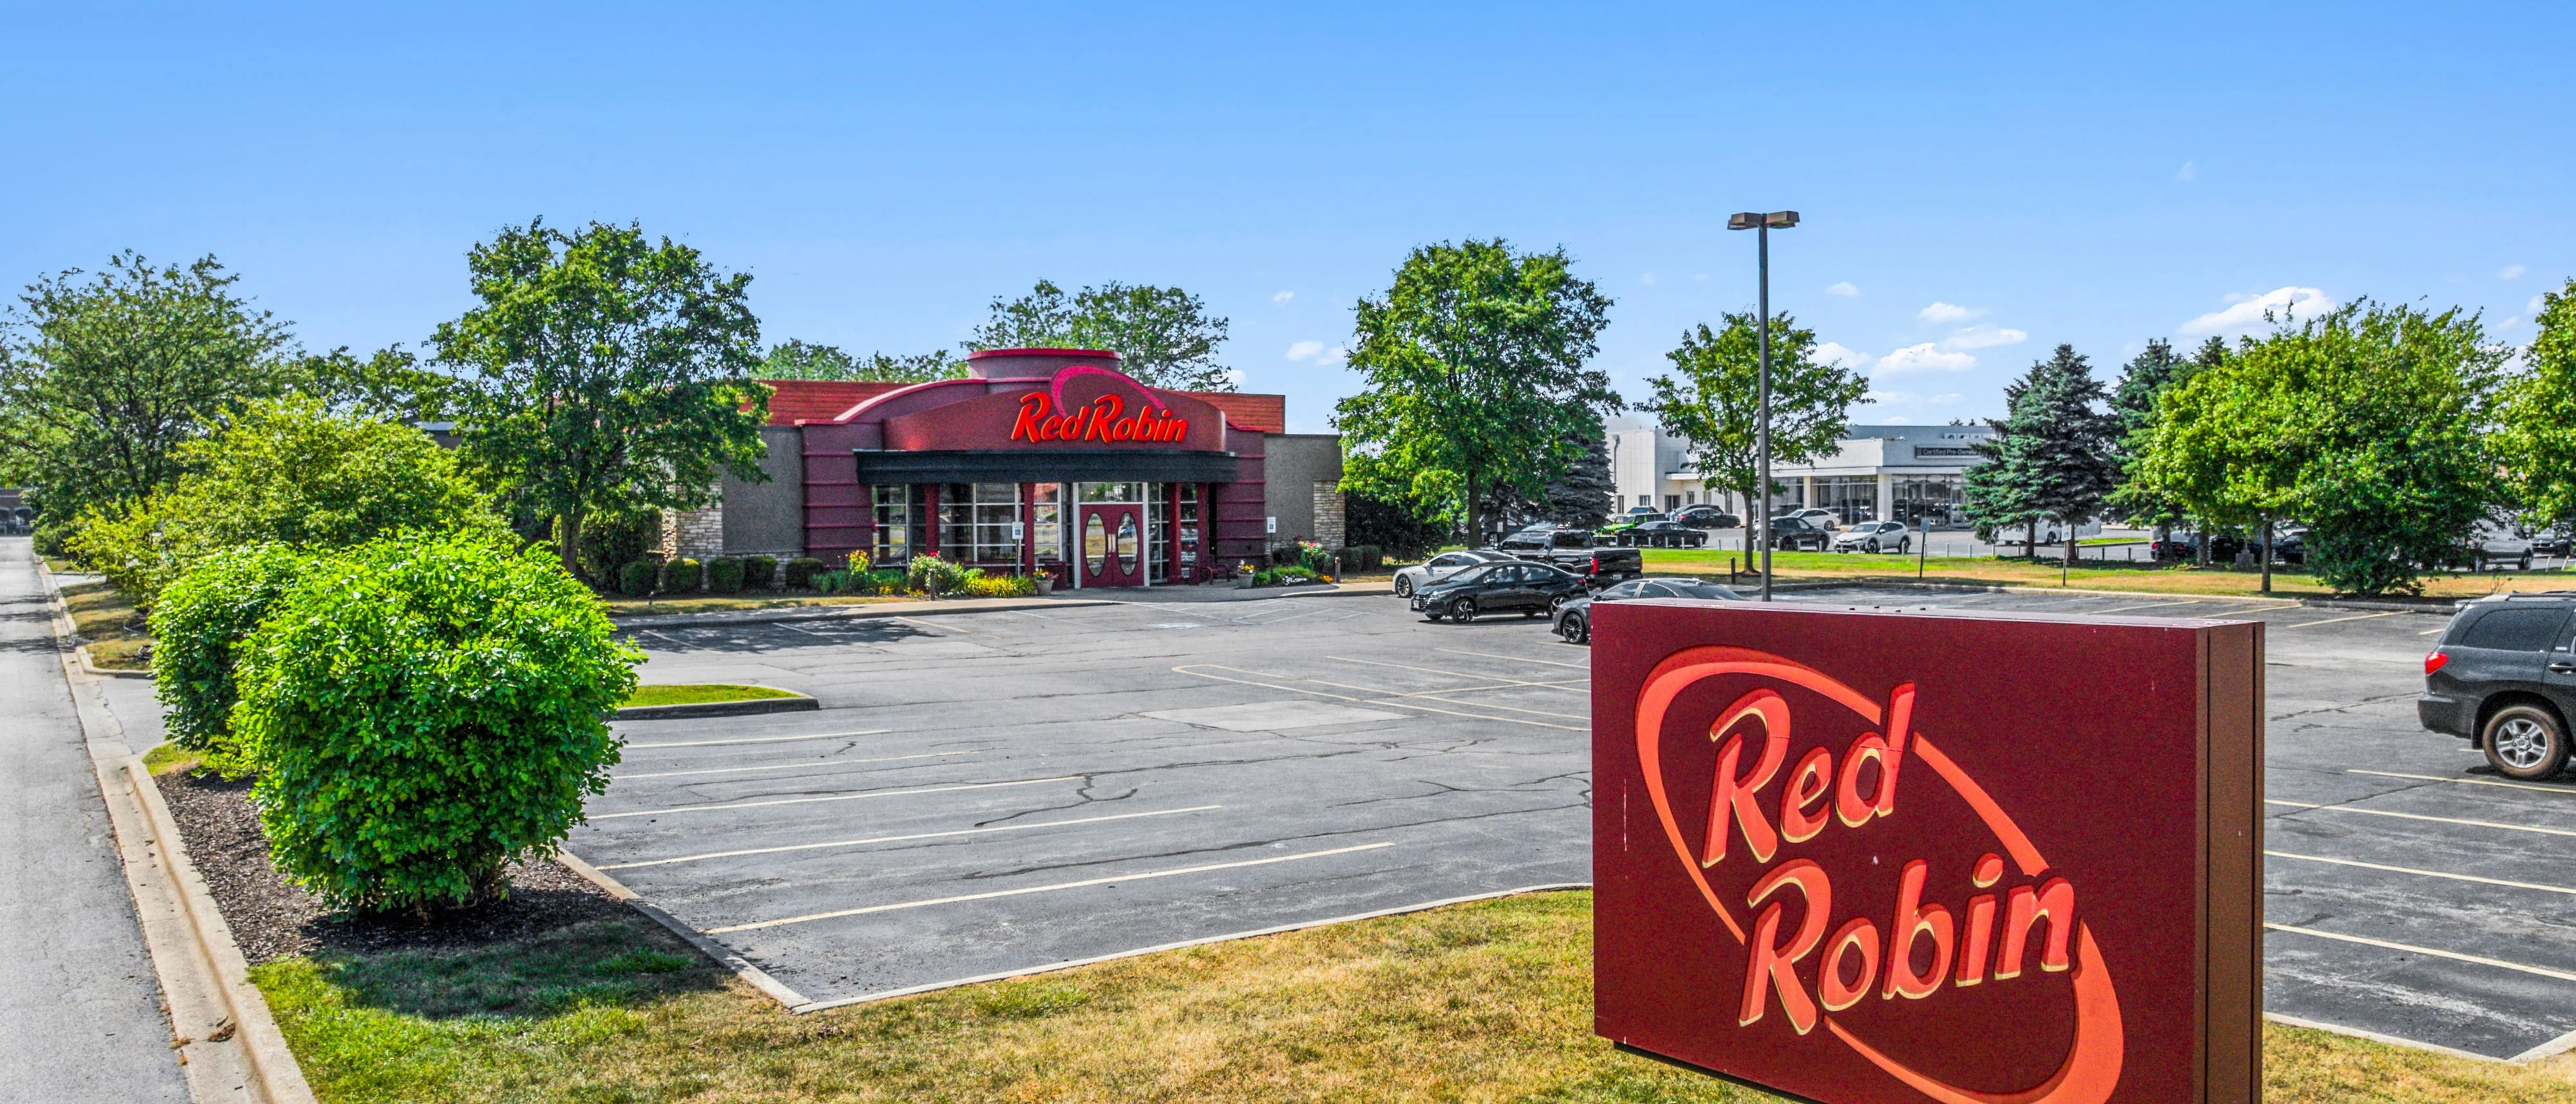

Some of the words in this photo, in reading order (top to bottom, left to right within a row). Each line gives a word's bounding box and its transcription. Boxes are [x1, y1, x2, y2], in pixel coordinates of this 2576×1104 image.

[1010, 392, 1090, 443] Red
[1084, 394, 1187, 443] Robin
[1701, 681, 1915, 869] Red
[1738, 852, 2075, 1036] Robin
